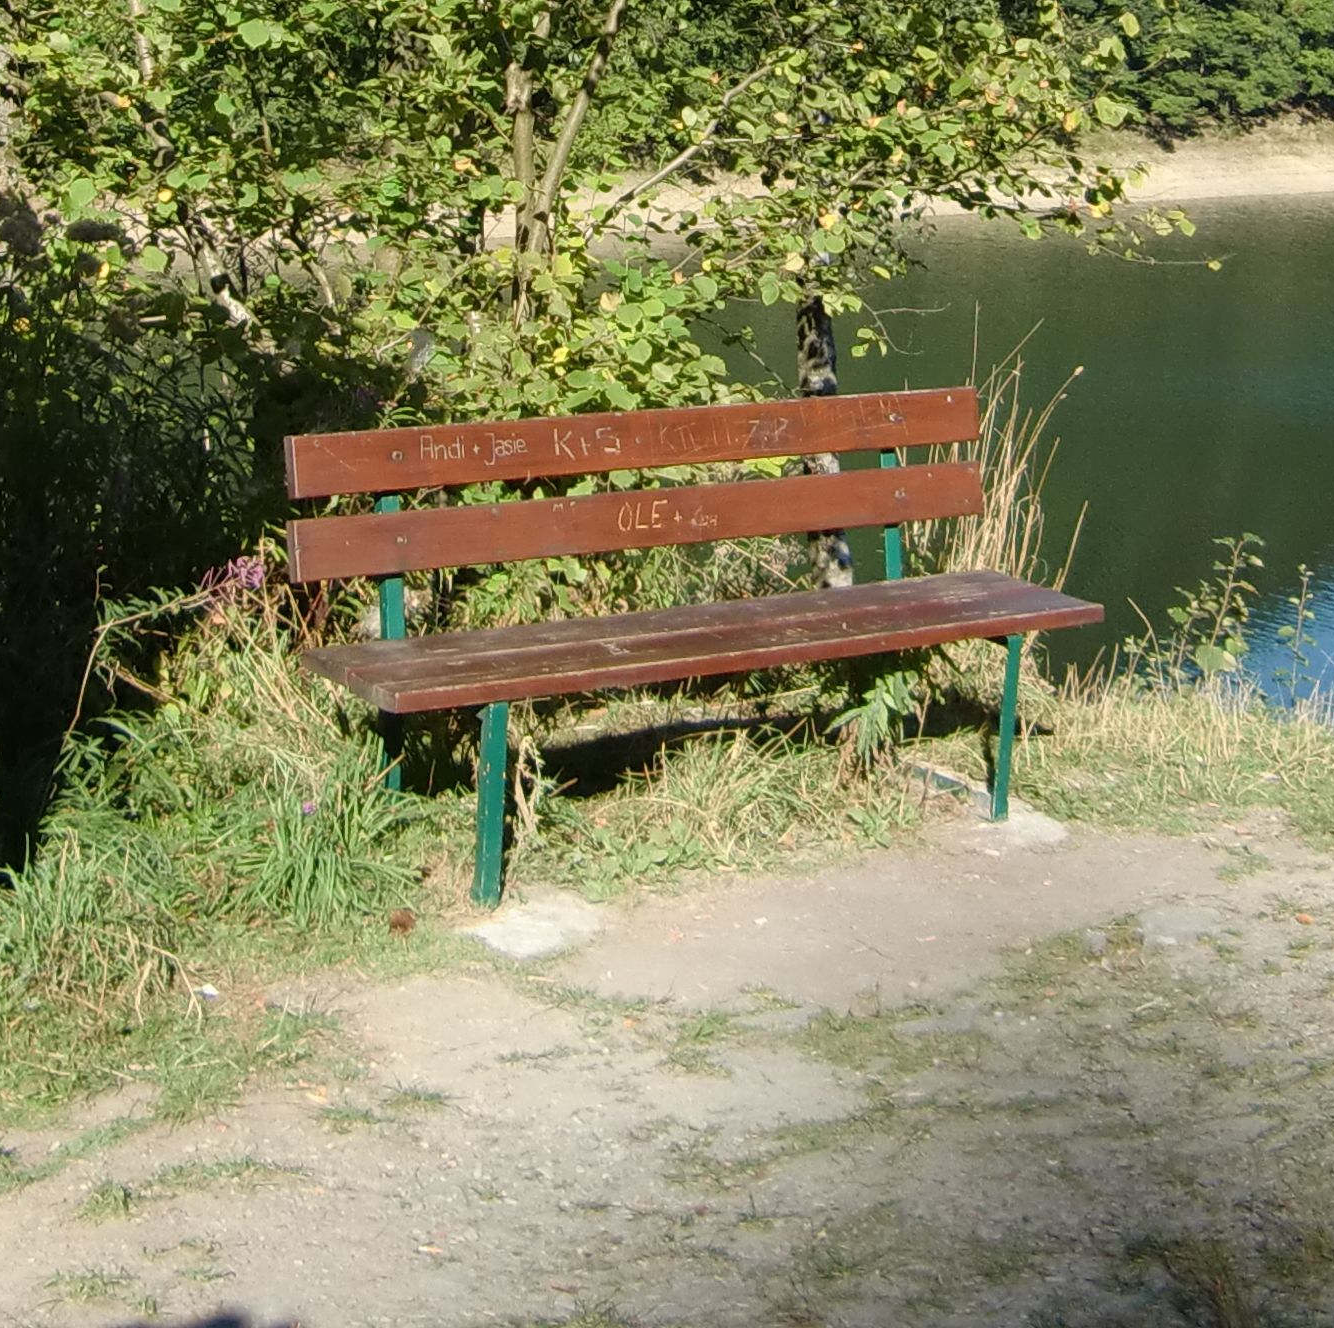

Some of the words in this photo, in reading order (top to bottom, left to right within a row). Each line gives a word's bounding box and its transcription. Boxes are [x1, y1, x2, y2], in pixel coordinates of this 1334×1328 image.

[419, 434, 465, 461] Andi
[472, 443, 481, 455] +
[483, 432, 528, 466] Jasie
[618, 499, 668, 532] OLE
[673, 509, 683, 523] +
